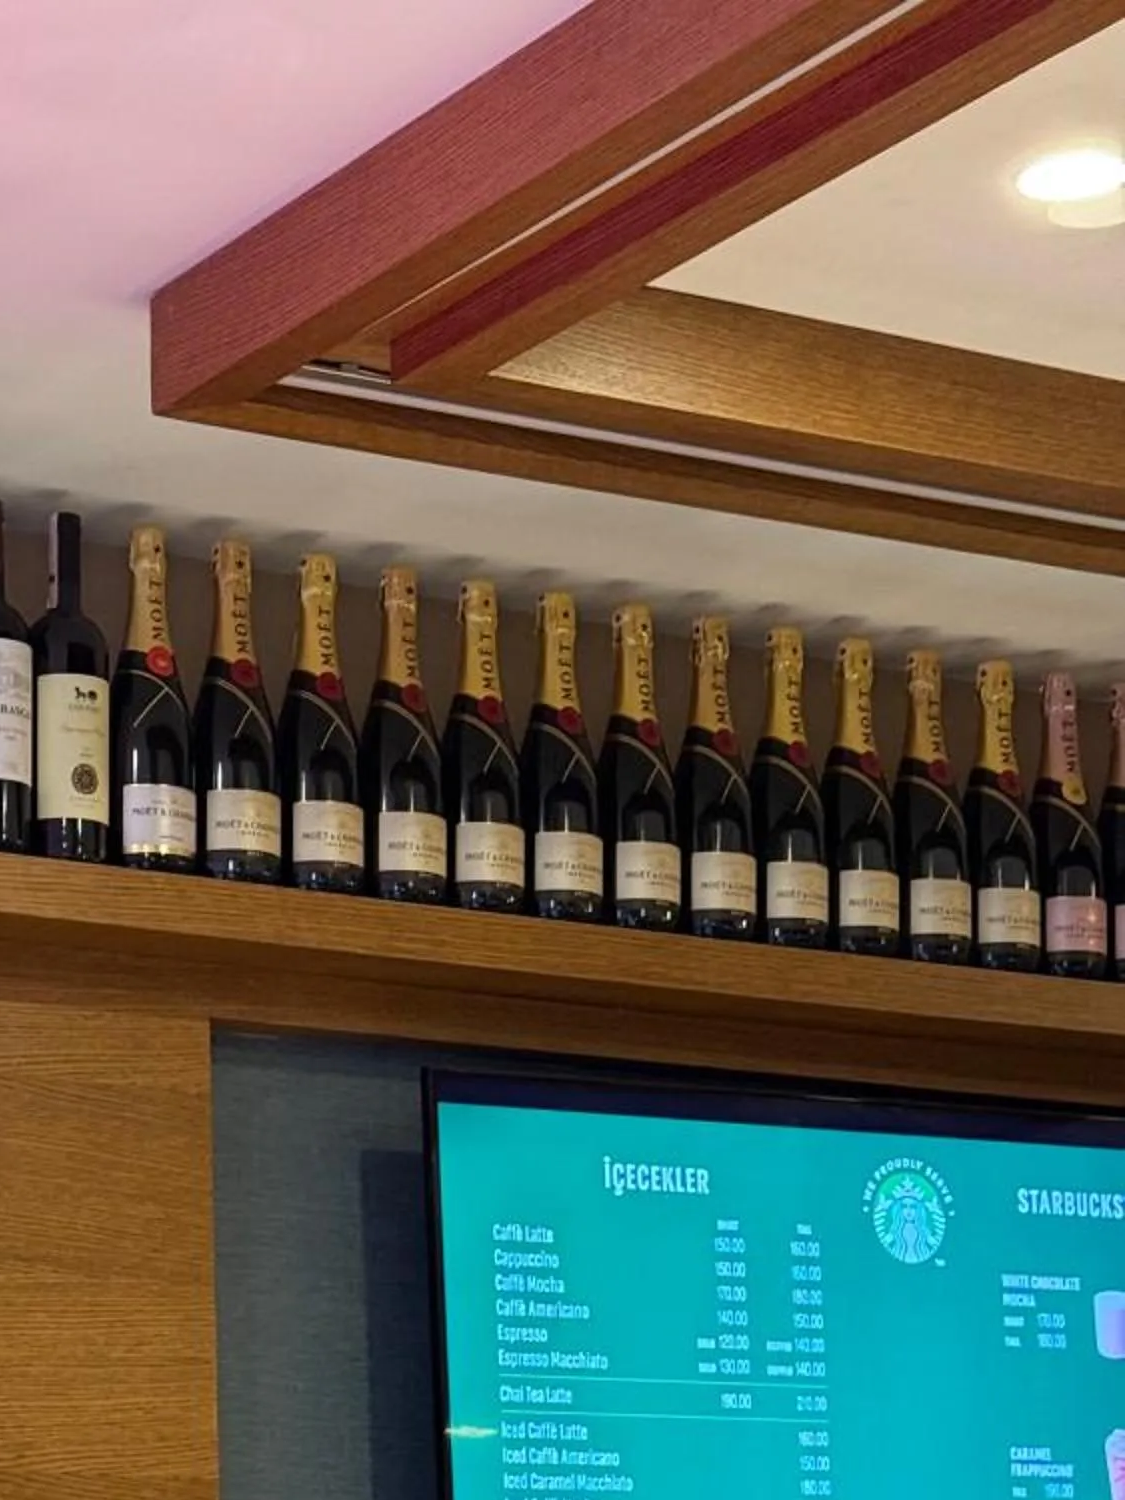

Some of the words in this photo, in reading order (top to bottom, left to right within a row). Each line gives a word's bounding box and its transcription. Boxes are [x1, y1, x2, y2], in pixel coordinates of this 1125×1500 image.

[603, 1156, 709, 1196] İÇECEKLER
[1017, 1188, 1125, 1220] STARBUCKS
[525, 1226, 554, 1243] Latte
[494, 1248, 559, 1268] Cappuccino
[527, 1275, 565, 1293] Mocha
[528, 1300, 589, 1319] Americano
[497, 1324, 548, 1344] Espresso
[498, 1348, 549, 1368] Espresso
[551, 1351, 608, 1370] Macchiato
[500, 1385, 524, 1402] Chai
[526, 1386, 545, 1403] Tea
[545, 1386, 572, 1404] Latte
[501, 1421, 525, 1439] Iced
[559, 1424, 588, 1440] Latte
[503, 1446, 527, 1464] Iced
[561, 1448, 620, 1466] Americano
[504, 1472, 528, 1489] Iced
[530, 1472, 575, 1490] Caramel
[577, 1474, 633, 1491] Macchiato
